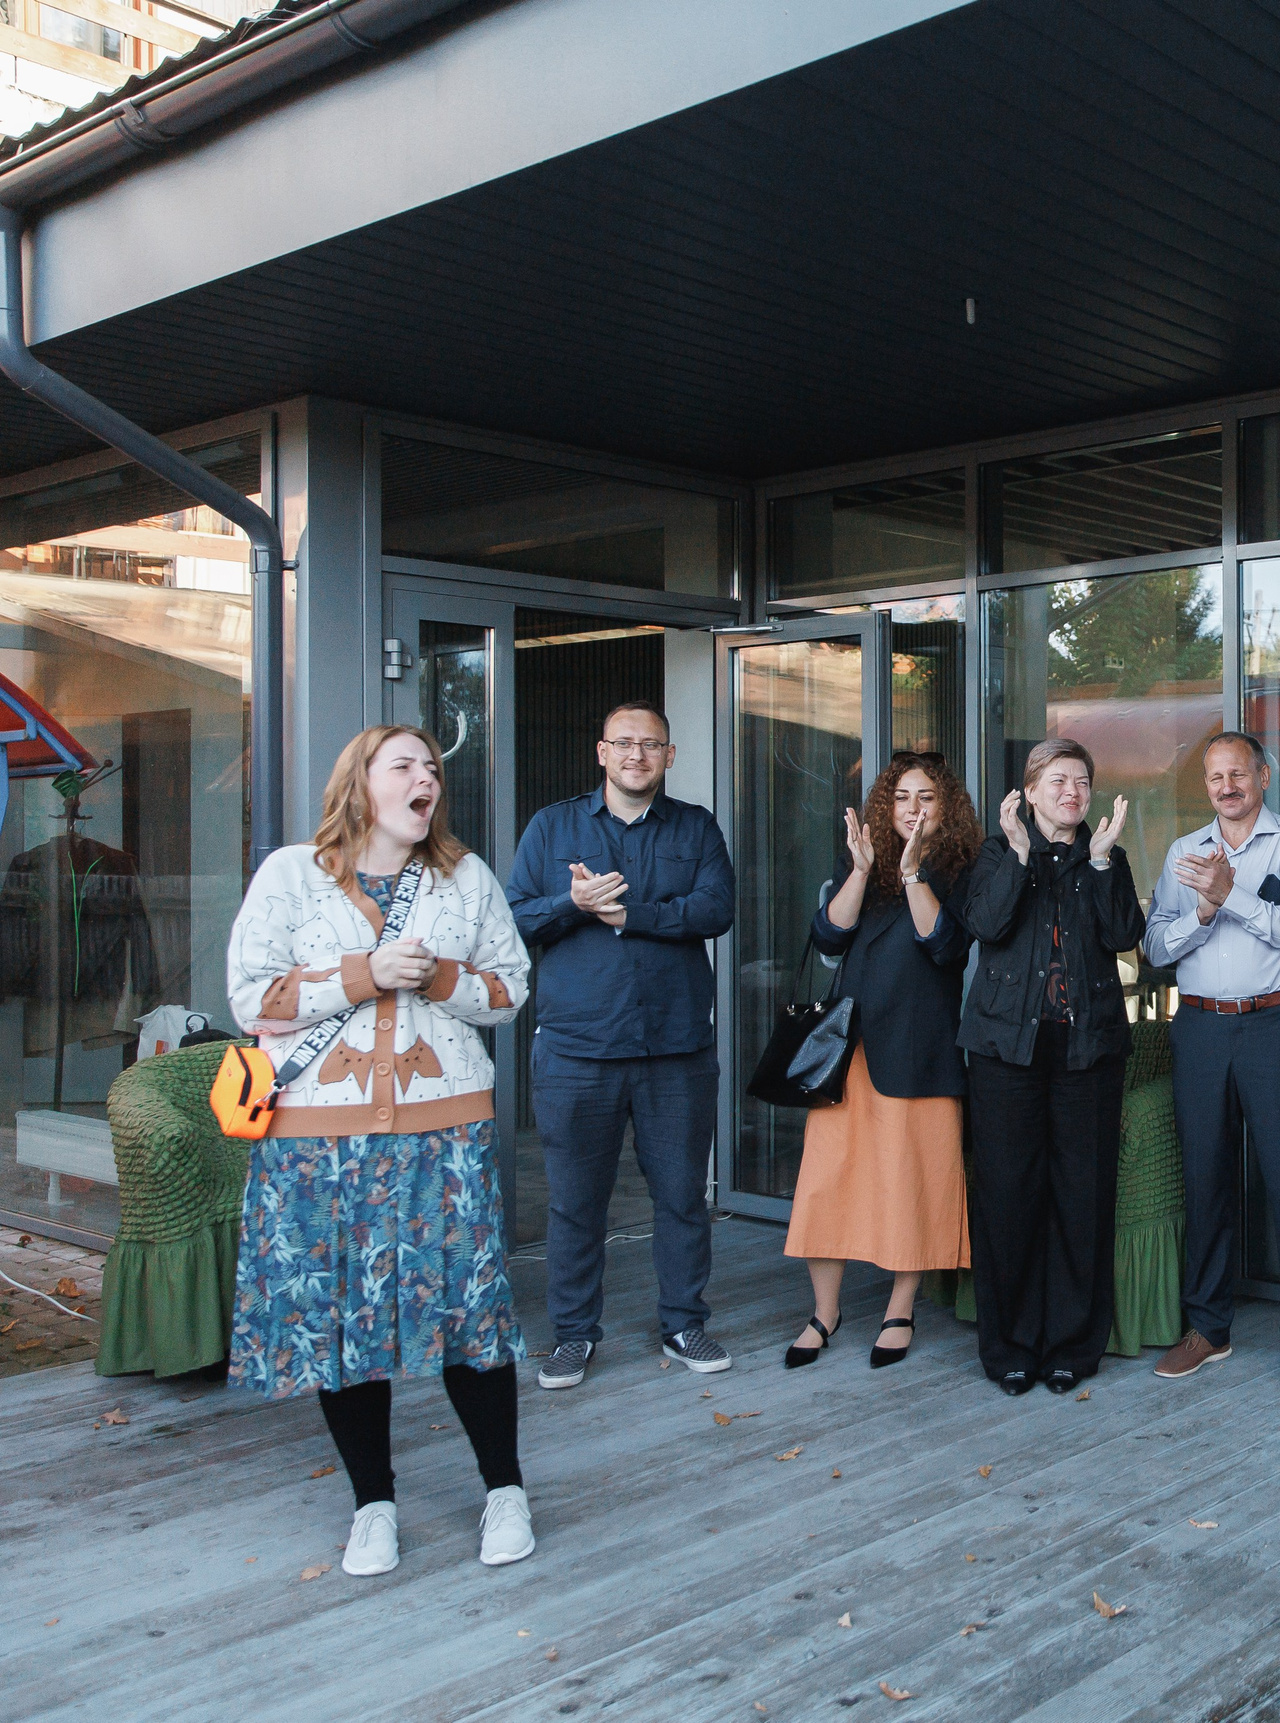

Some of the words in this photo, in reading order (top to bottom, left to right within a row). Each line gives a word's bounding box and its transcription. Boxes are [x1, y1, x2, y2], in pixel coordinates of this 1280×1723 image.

[395, 871, 420, 901] NICE
[385, 898, 412, 930] NICE
[305, 1016, 343, 1050] NICE
